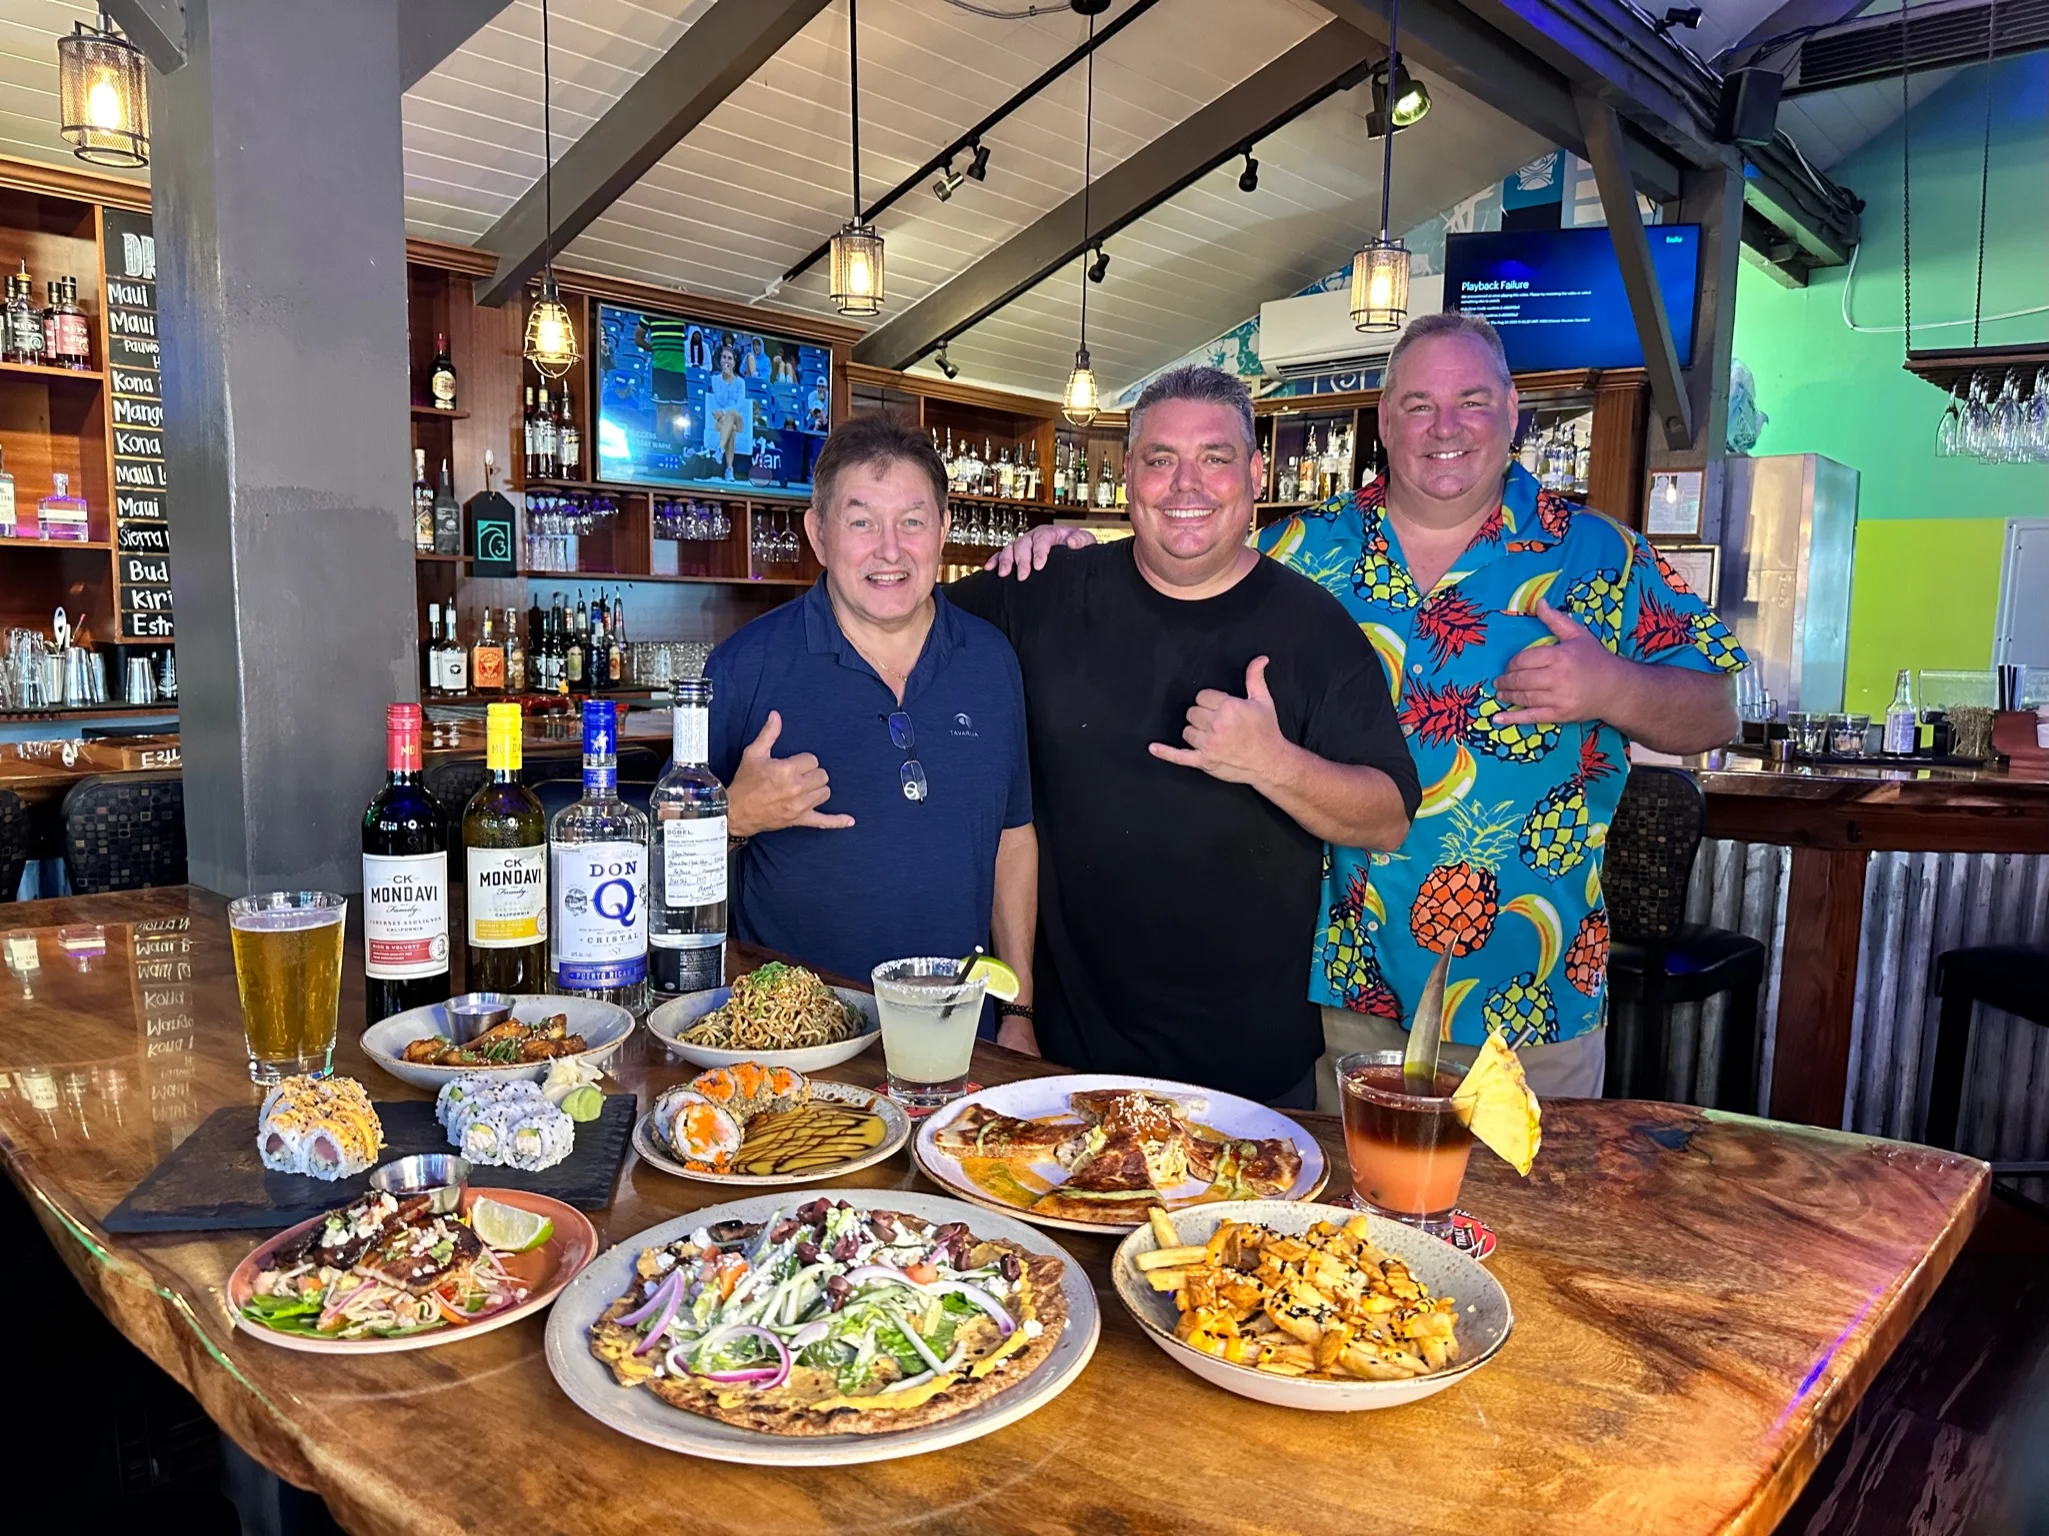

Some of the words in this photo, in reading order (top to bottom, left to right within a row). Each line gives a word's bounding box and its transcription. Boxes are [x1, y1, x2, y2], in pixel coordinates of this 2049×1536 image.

[108, 284, 148, 307] Maui
[1461, 280, 1500, 292] Playback
[1500, 280, 1529, 290] Failure
[110, 312, 155, 335] Maui
[112, 370, 153, 393] Kona
[115, 432, 161, 455] Kona
[115, 465, 154, 485] Maui
[117, 497, 159, 517] Maui
[119, 528, 162, 547] Sierra
[129, 560, 168, 582] Bud
[949, 729, 980, 738] TAVARUA
[504, 859, 522, 868] CK
[589, 860, 637, 877] DON
[393, 875, 413, 884] CK
[480, 868, 542, 887] MONDAVI
[371, 885, 438, 904] MONDAVI
[592, 878, 636, 927] Q
[587, 932, 639, 944] CRISTAL
[576, 971, 606, 980] PUERTO
